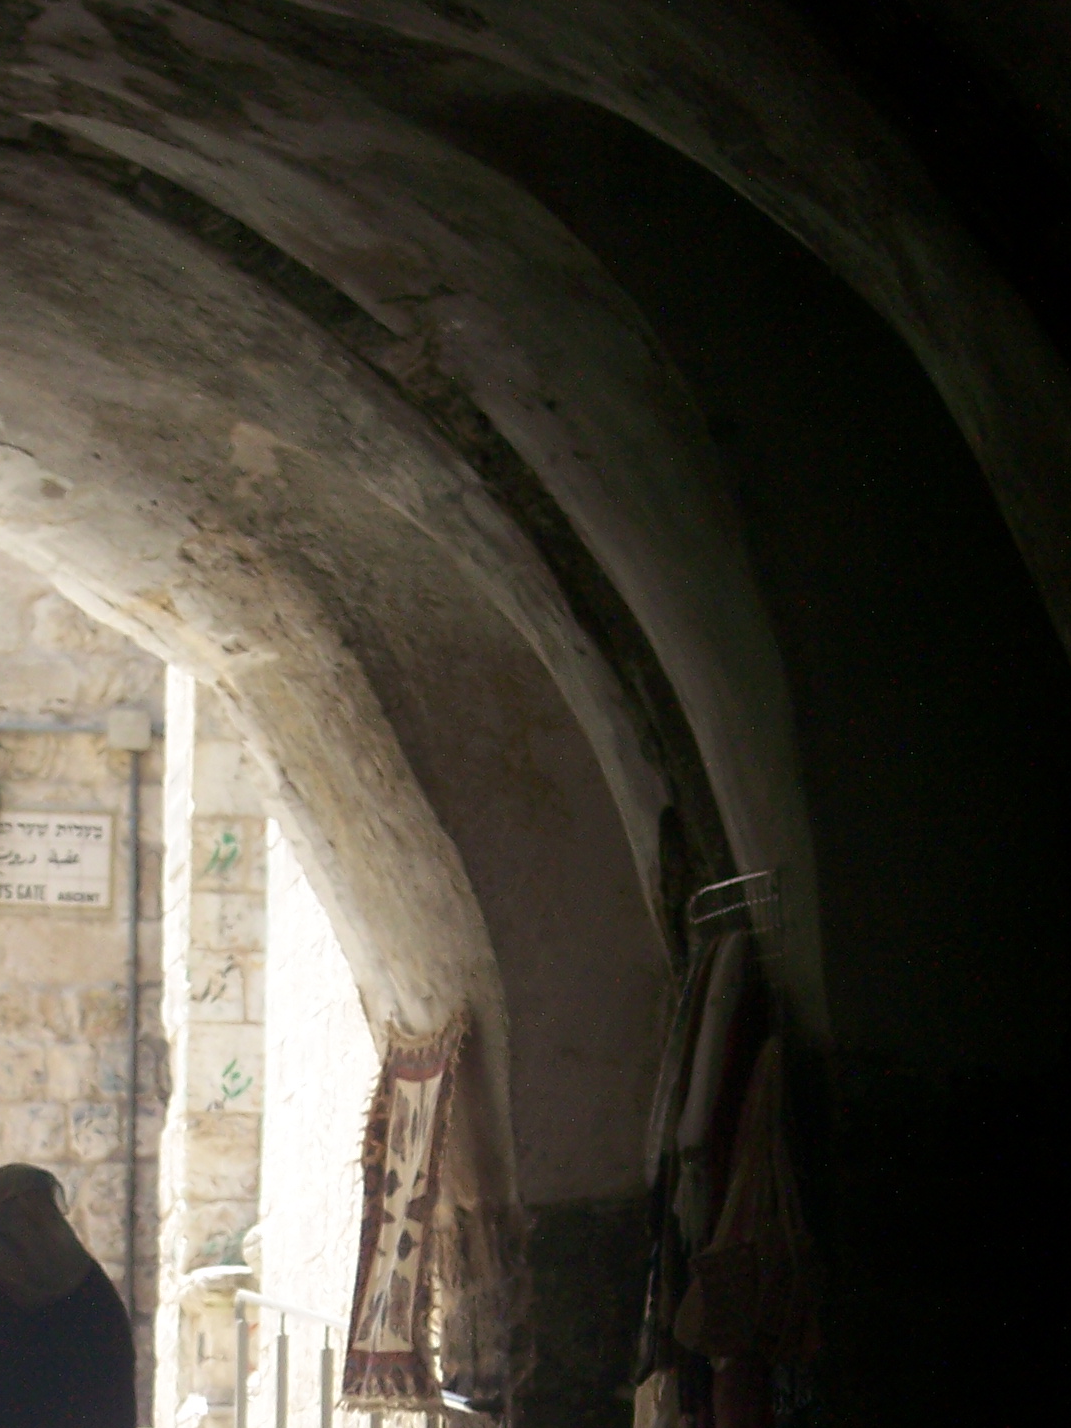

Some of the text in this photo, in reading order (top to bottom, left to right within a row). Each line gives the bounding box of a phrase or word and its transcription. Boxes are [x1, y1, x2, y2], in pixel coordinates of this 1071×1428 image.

[16, 821, 49, 837] שער
[16, 883, 47, 900] GATE
[57, 891, 101, 903] ASCENT
